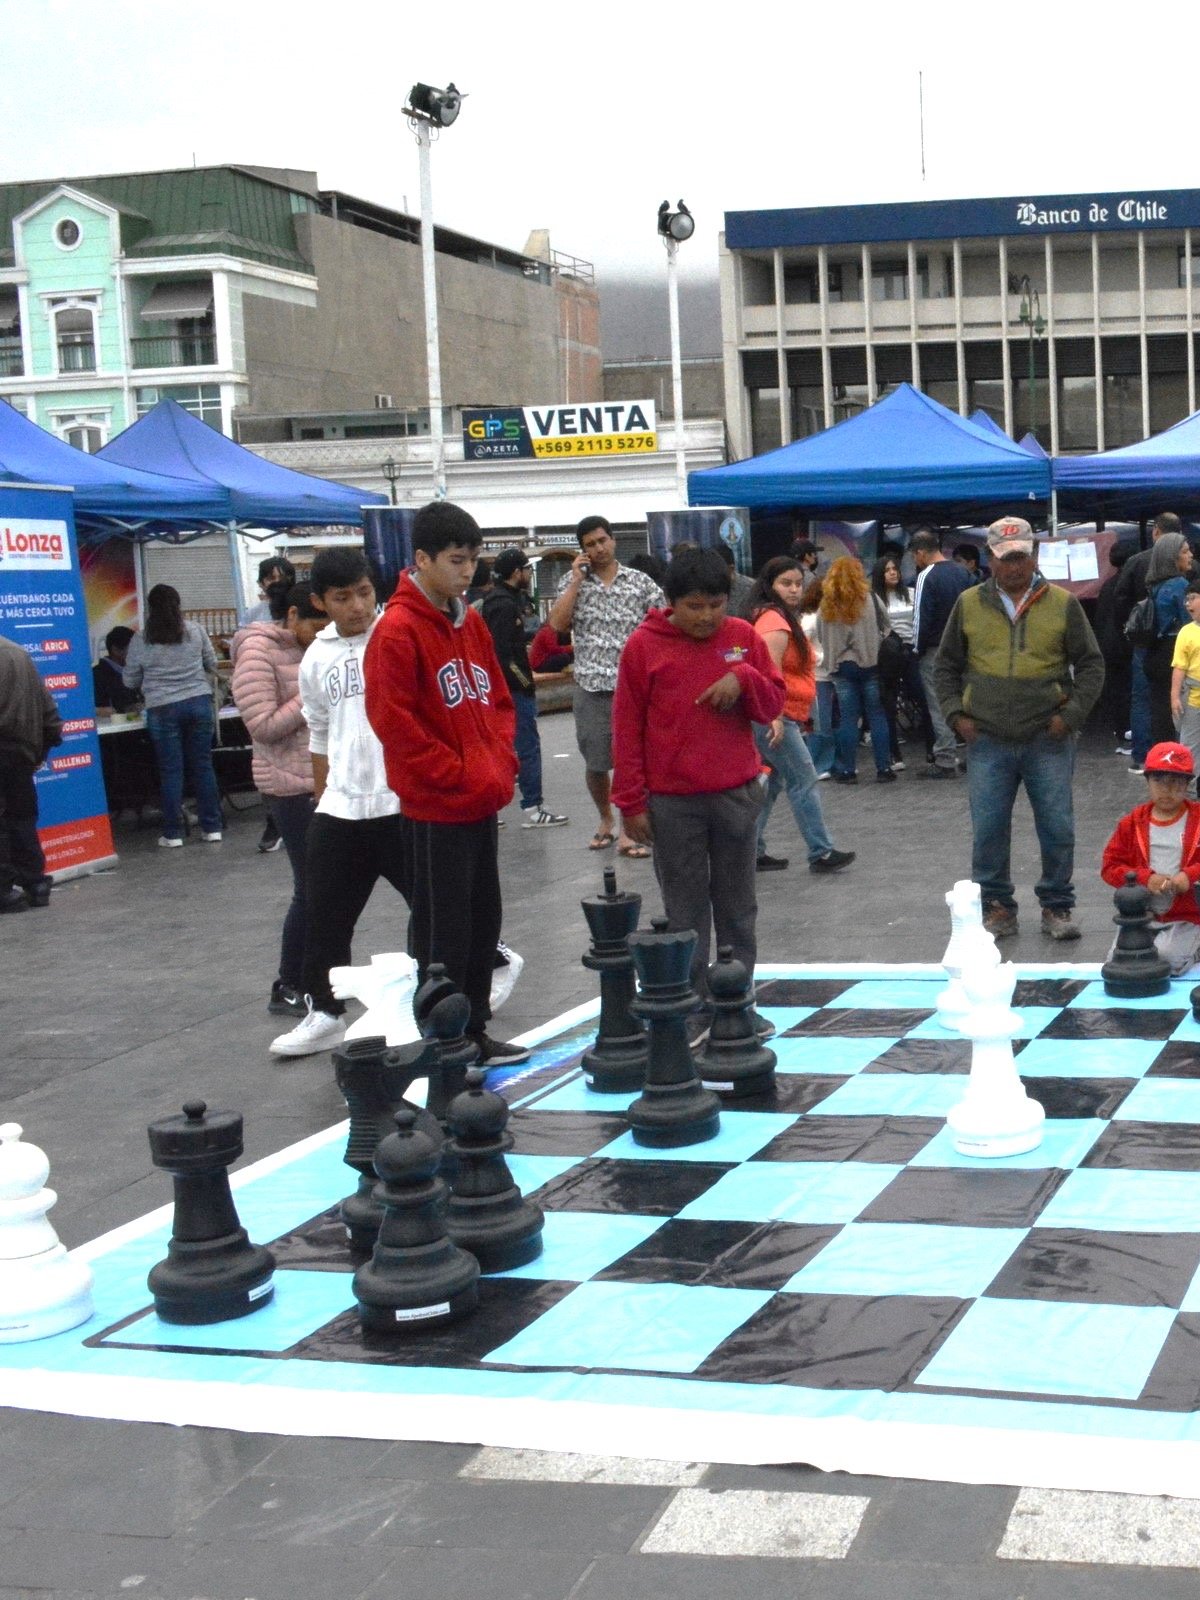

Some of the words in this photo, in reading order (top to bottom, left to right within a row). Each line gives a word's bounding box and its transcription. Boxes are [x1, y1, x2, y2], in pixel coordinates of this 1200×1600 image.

[1016, 202, 1081, 226] Banco
[1089, 203, 1109, 223] de
[1117, 199, 1168, 223] Chile
[468, 418, 520, 438] GPS
[532, 405, 649, 436] VENTA
[536, 442, 572, 454] +569
[577, 439, 613, 451] 2113
[617, 436, 654, 449] 5276
[5, 528, 62, 552] Lonza
[0, 593, 51, 604] UÉNTRANOS
[52, 593, 75, 603] CADA
[6, 607, 24, 618] MÁS
[25, 608, 52, 617] CERCA
[53, 607, 75, 616] TUYO
[45, 641, 69, 652] ARICA
[45, 675, 77, 688] IQUIQUE
[437, 658, 491, 708] GAP
[52, 755, 91, 769] VALLENAR
